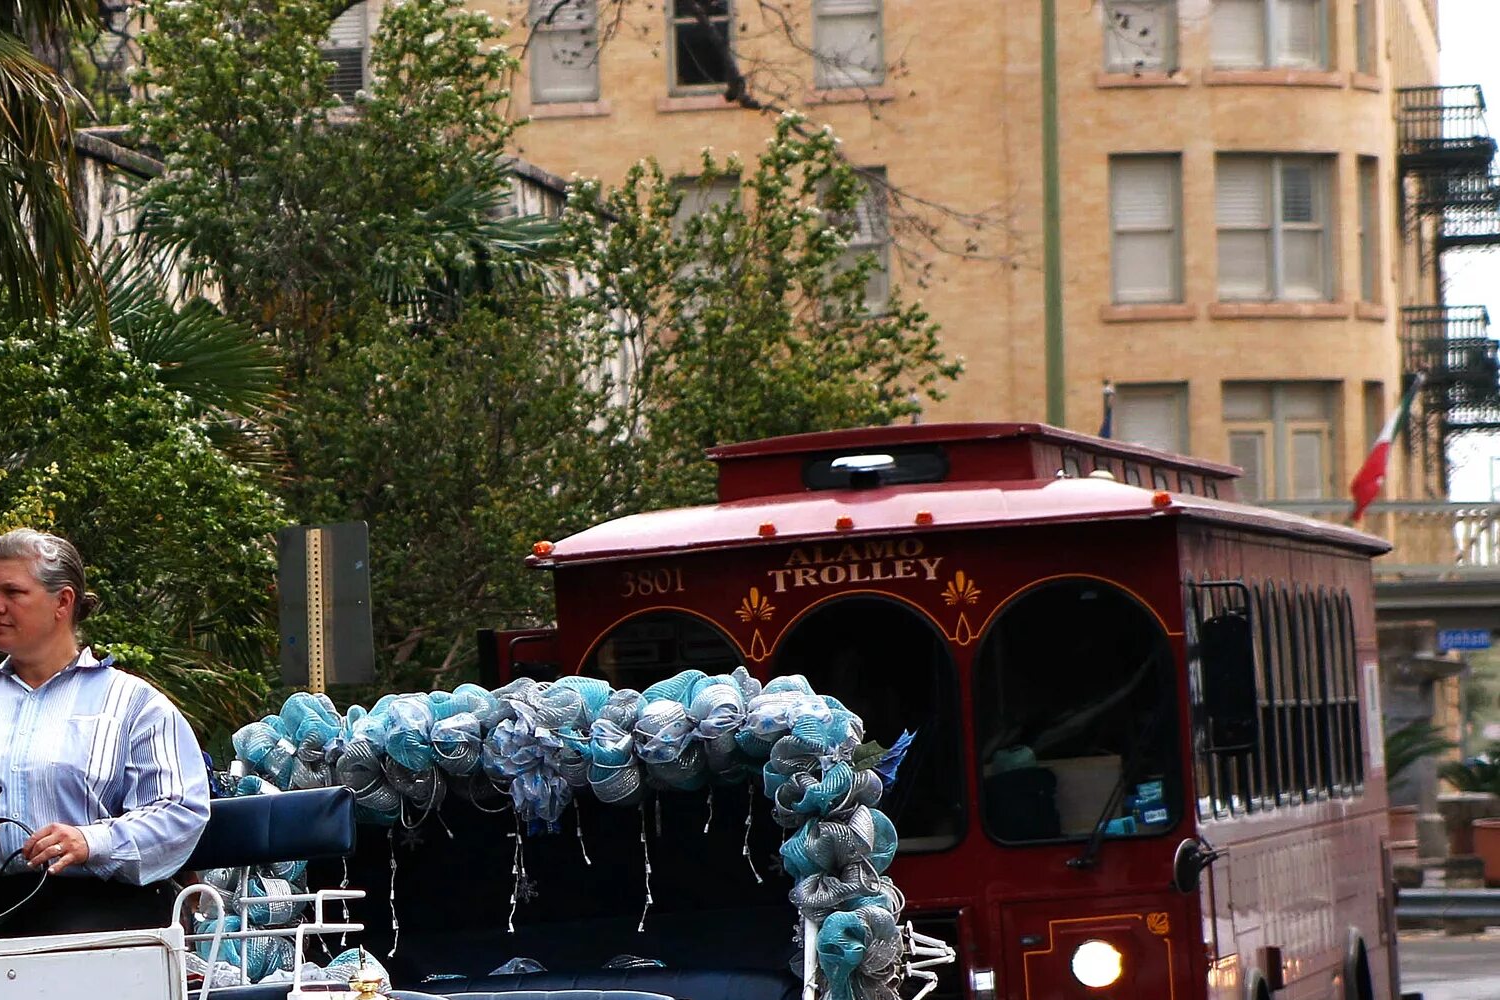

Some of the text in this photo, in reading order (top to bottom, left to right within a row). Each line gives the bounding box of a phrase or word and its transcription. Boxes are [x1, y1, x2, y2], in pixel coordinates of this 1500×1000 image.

[785, 538, 924, 566] ALAMO
[620, 567, 685, 598] 3801
[767, 557, 943, 593] TROLLEY
